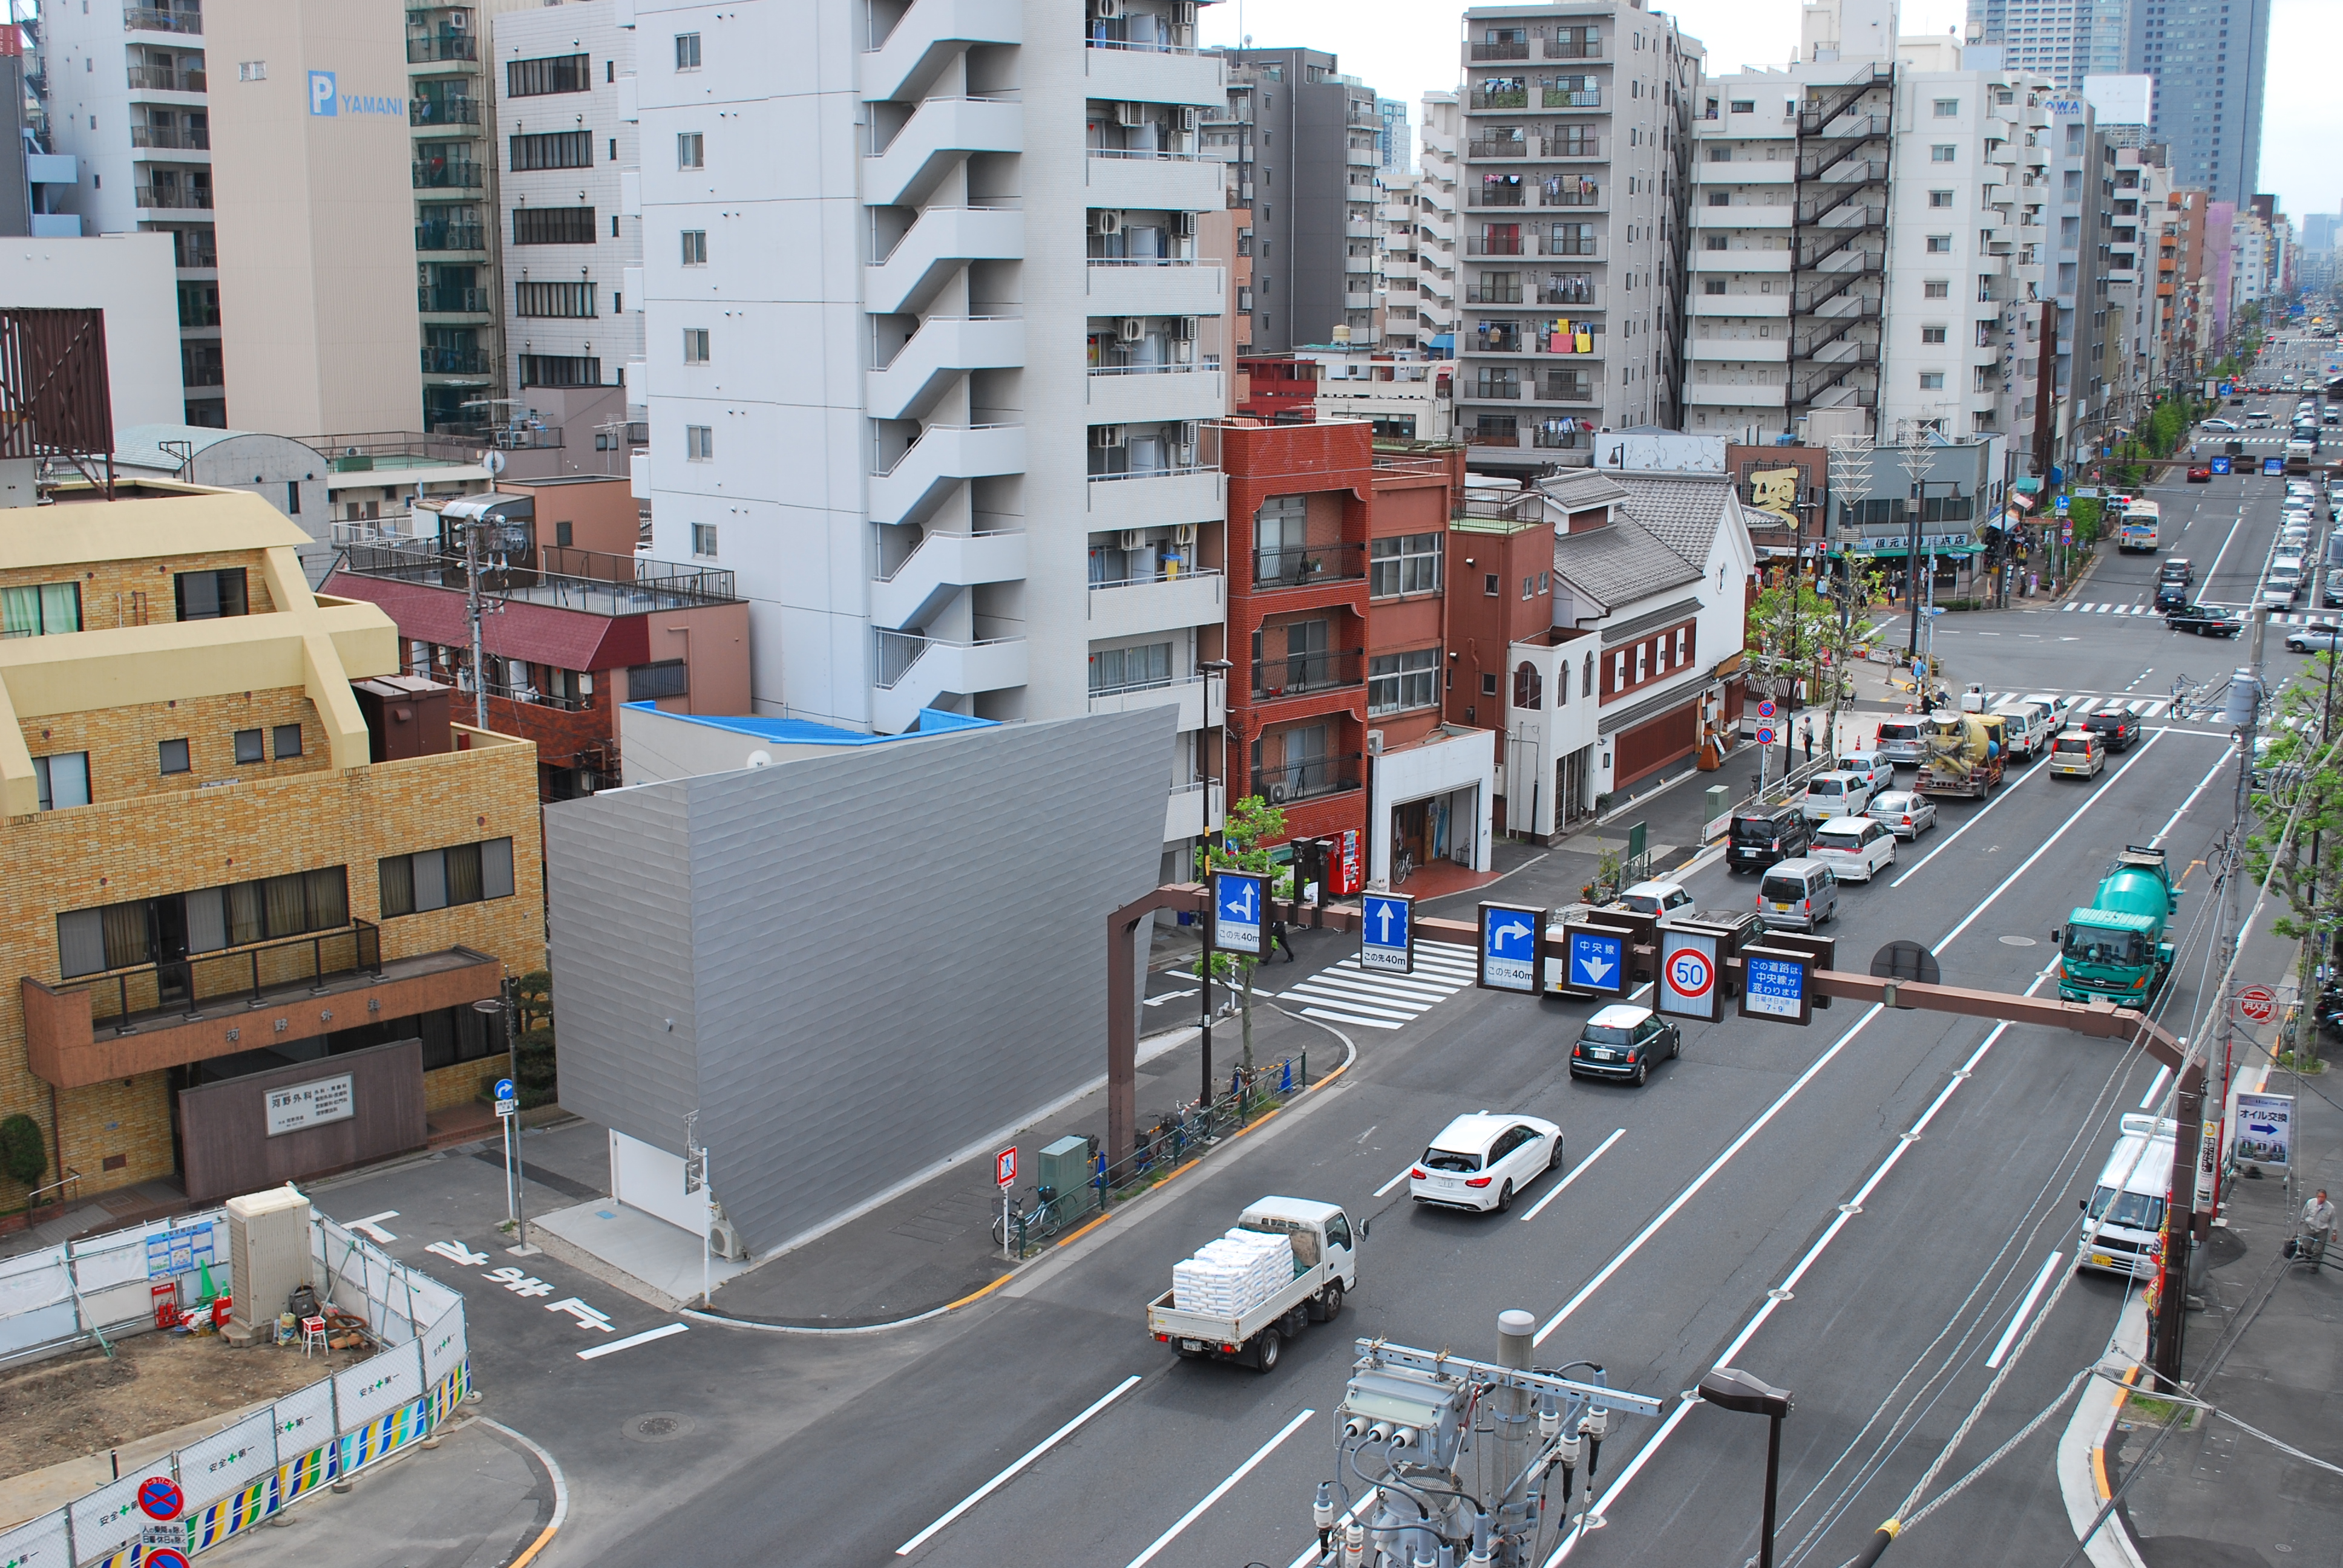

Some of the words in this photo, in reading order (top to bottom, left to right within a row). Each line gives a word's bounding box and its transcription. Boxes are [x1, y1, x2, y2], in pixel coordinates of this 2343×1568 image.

[312, 75, 333, 113] P
[342, 95, 402, 116] YAMANI
[2002, 299, 2017, 393] バレエスタジオ
[1219, 929, 1260, 943] この先40m
[1579, 940, 1615, 955] 中央線
[1365, 952, 1406, 966] この先40m
[1487, 966, 1533, 981] この先40m
[1676, 962, 1703, 986] 50
[1755, 972, 1797, 986] 中央線が
[1752, 982, 1800, 998] 変わります
[226, 999, 382, 1042] 河野外科
[272, 1091, 313, 1109] 河野外科
[2240, 1109, 2287, 1123] オイル交換
[19, 1550, 39, 1566] 第一
